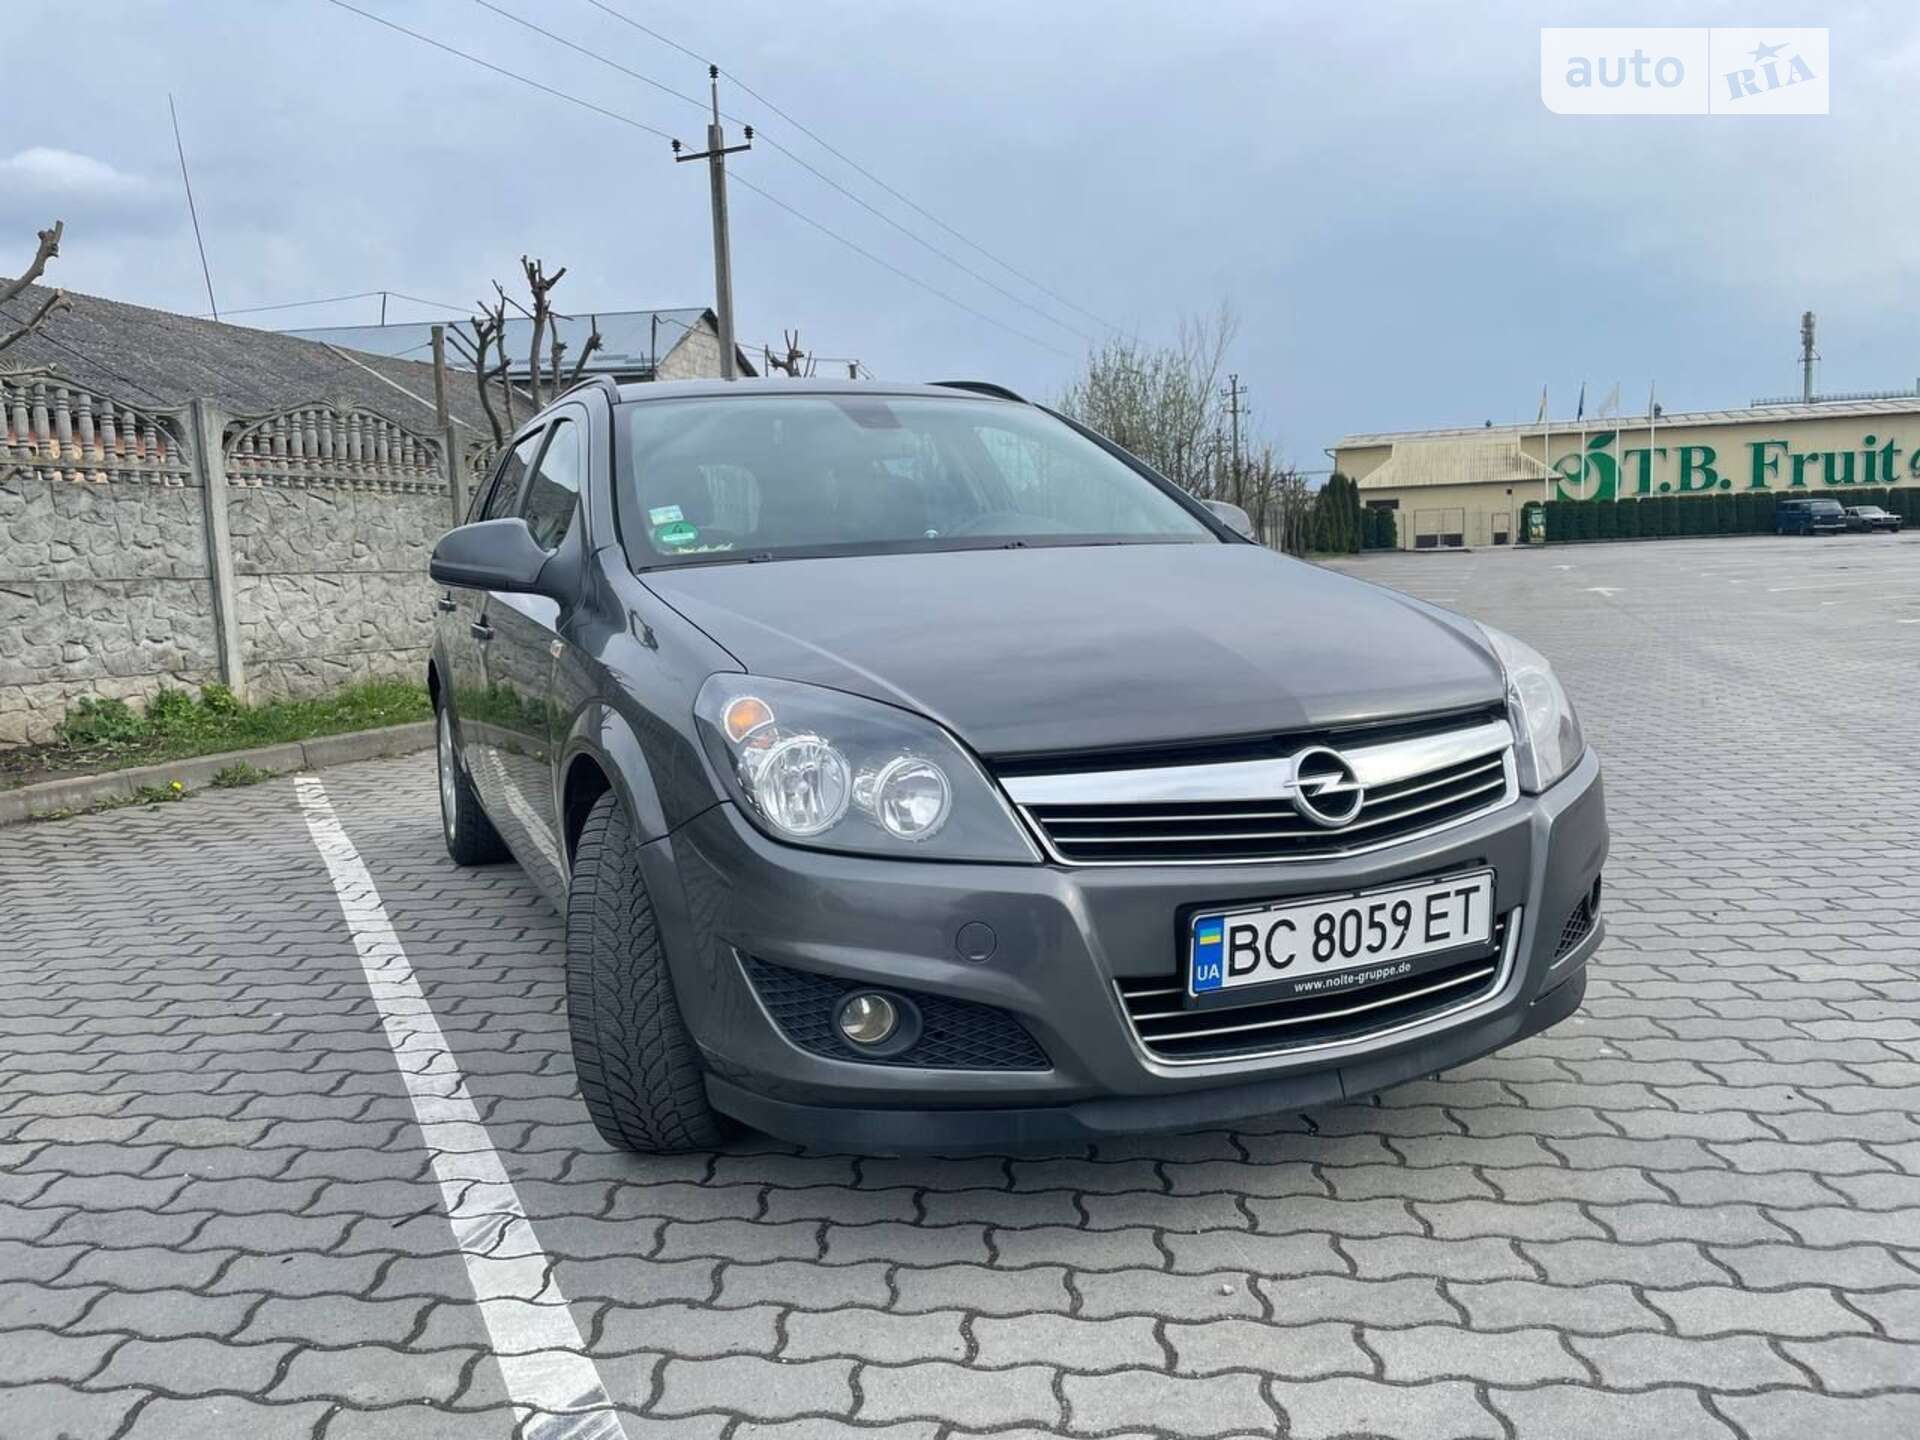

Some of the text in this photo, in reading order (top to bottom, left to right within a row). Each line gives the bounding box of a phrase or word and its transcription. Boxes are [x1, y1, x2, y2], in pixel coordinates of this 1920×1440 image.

[1624, 445, 1732, 494] T.B.
[1228, 884, 1481, 978] BC 8059 ET
[1197, 964, 1221, 982] UA
[1294, 962, 1412, 993] www.nolte-gruppe.de
